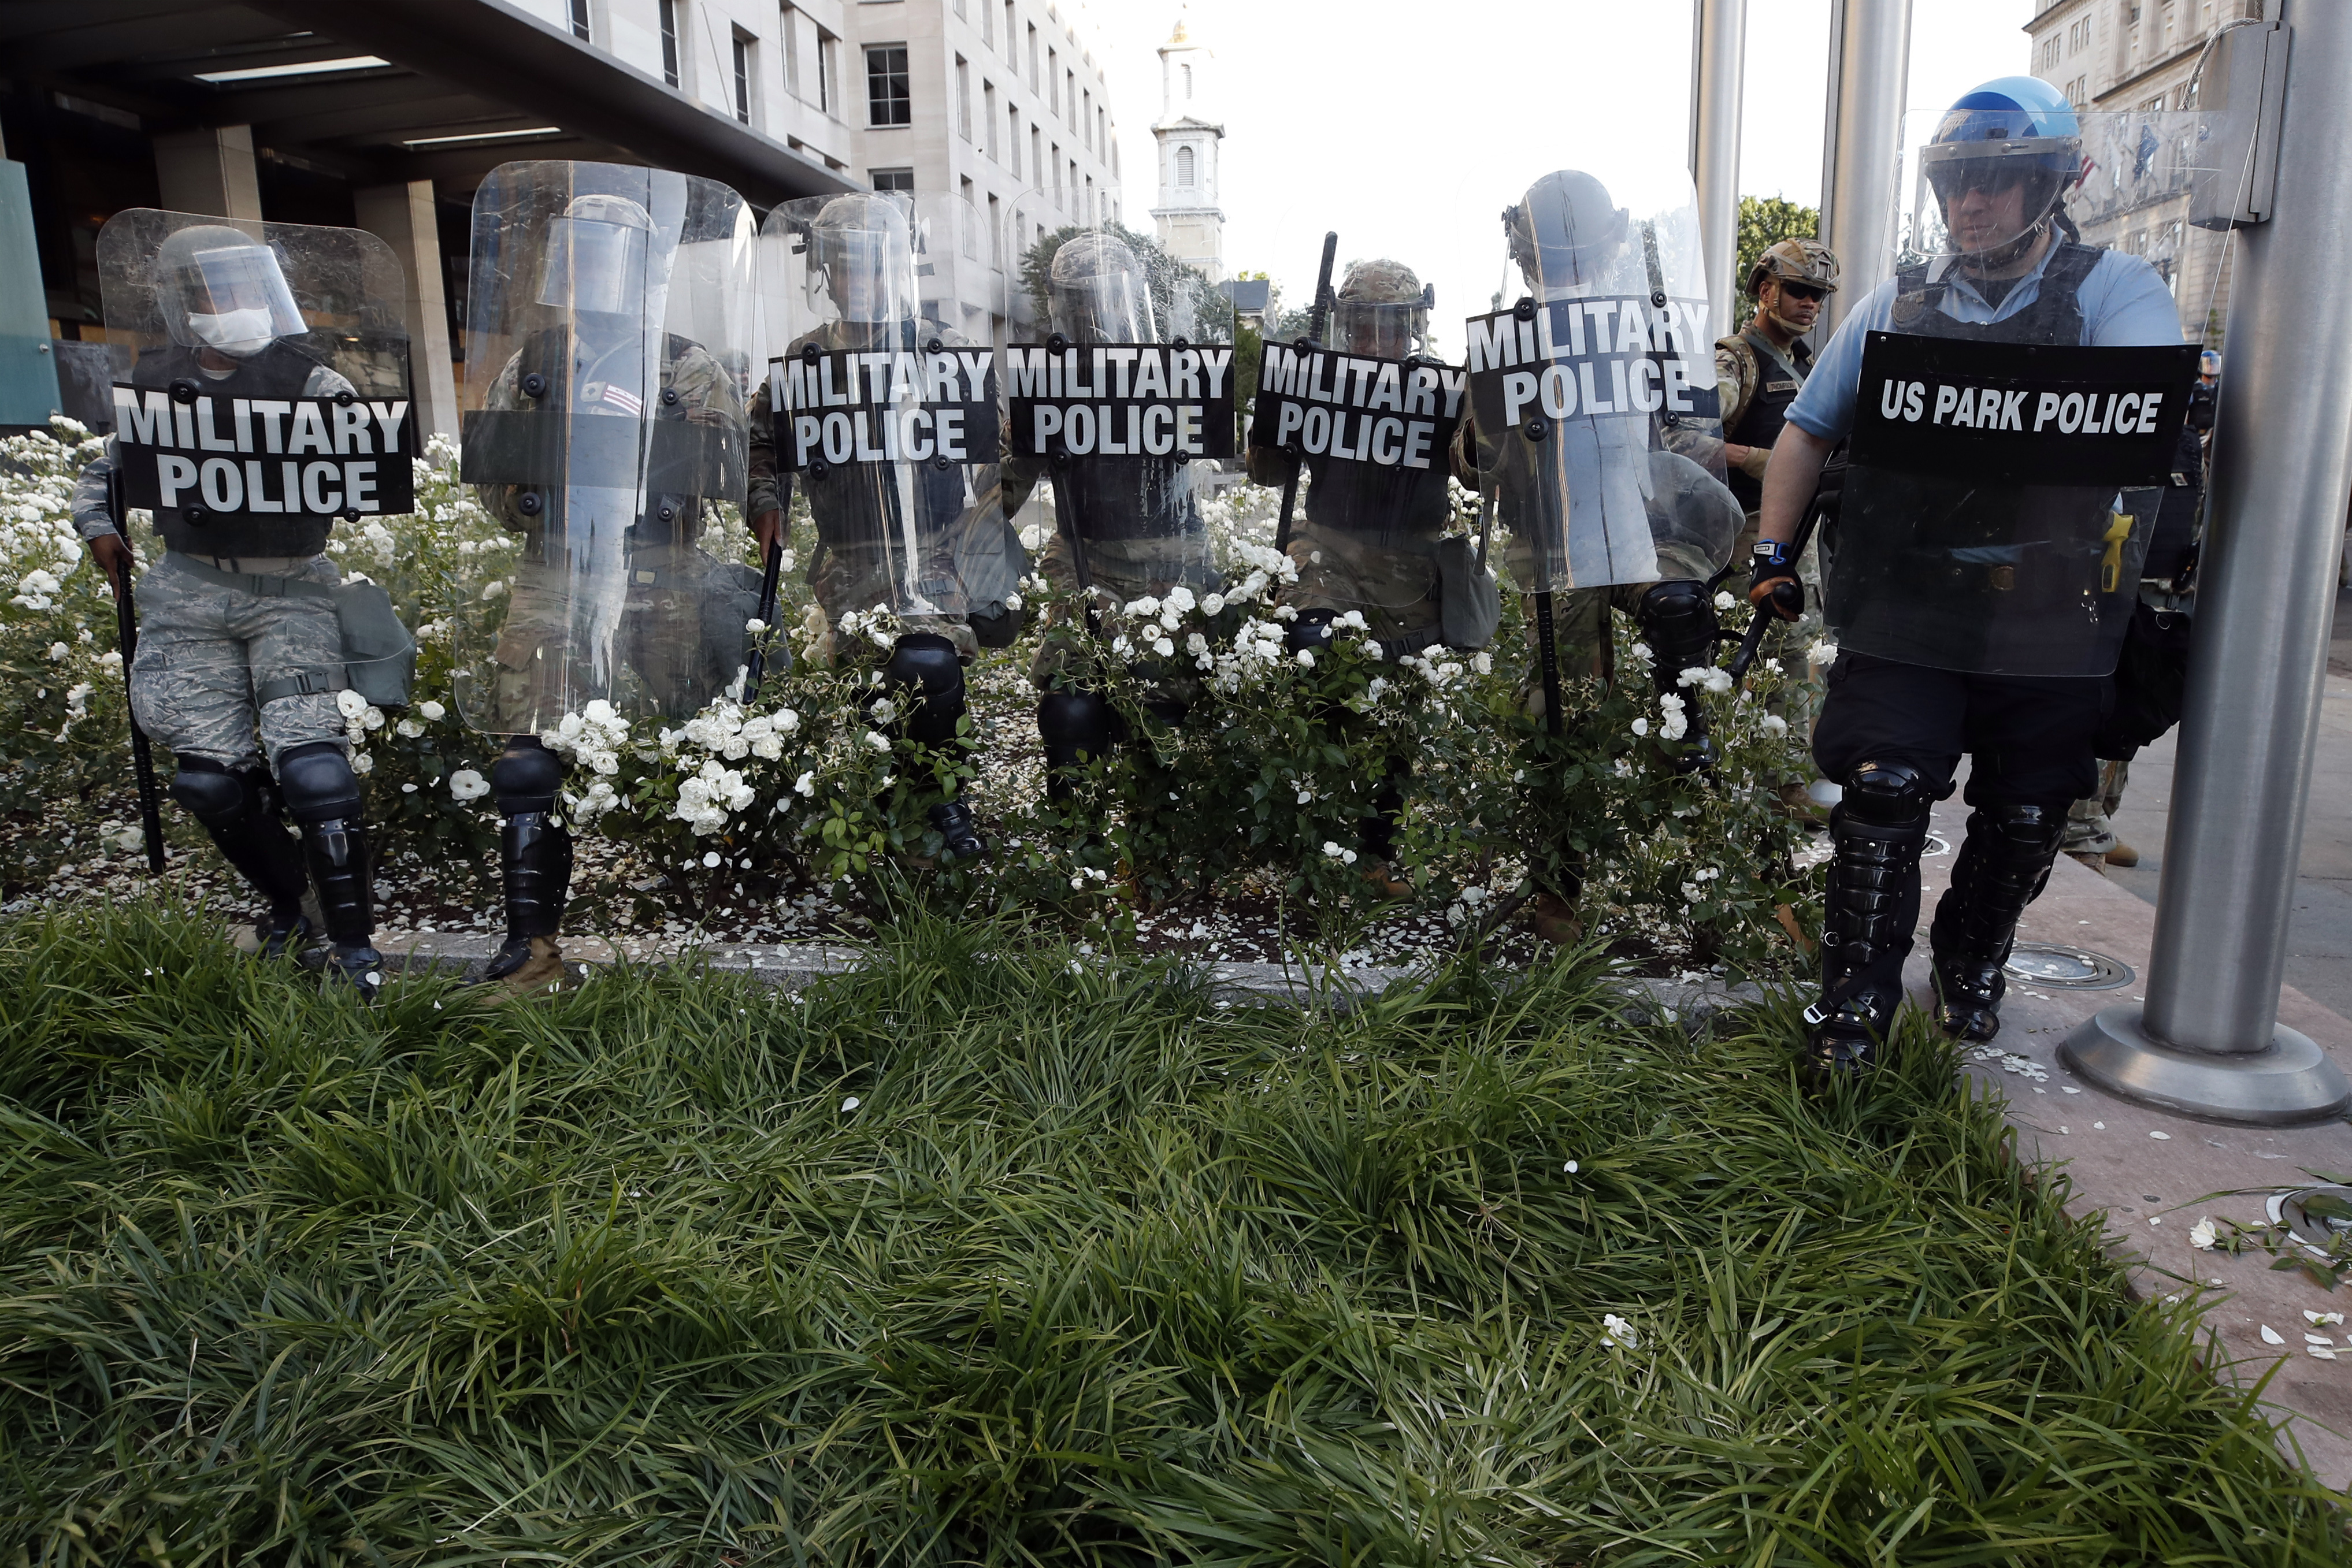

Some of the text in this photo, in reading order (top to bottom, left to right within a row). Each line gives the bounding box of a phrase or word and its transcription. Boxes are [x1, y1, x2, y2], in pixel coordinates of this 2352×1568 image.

[1467, 300, 1709, 373] MILITARY
[769, 352, 993, 412] MILITARY
[1007, 347, 1232, 398] MILITARY
[1263, 345, 1467, 418] MILITARY
[1503, 358, 1693, 426] POLICE
[112, 387, 408, 454] MILITARY
[1034, 404, 1203, 455] POLICE
[1277, 401, 1434, 469] POLICE
[1881, 379, 2163, 434] US PARK POLICE
[795, 408, 967, 466] POLICE
[156, 454, 379, 514] POLICE
